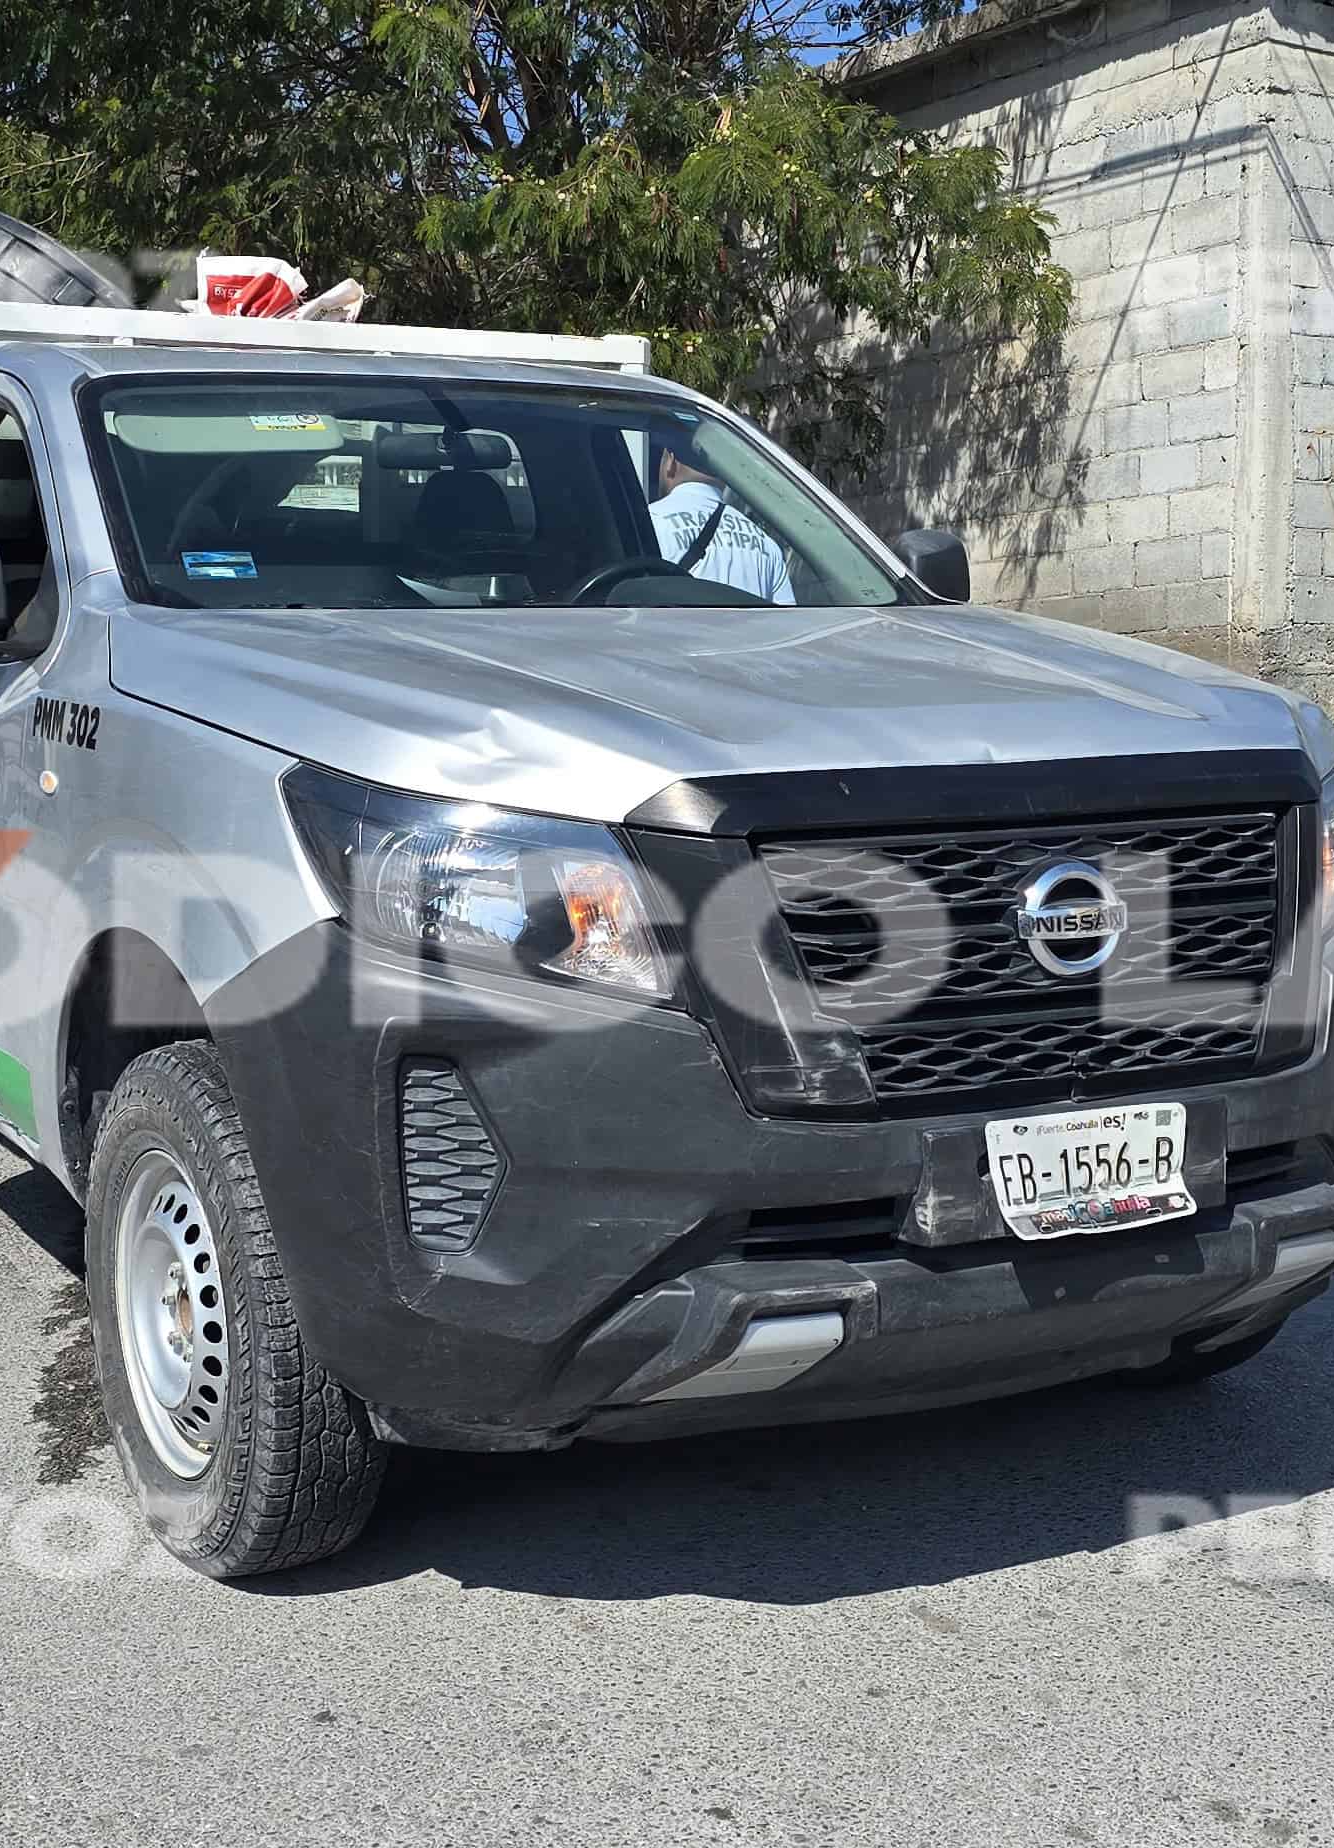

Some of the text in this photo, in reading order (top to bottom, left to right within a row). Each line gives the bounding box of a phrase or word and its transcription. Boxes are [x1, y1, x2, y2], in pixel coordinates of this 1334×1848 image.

[33, 696, 100, 750] PMM 302
[1036, 911, 1124, 933] NISSAN
